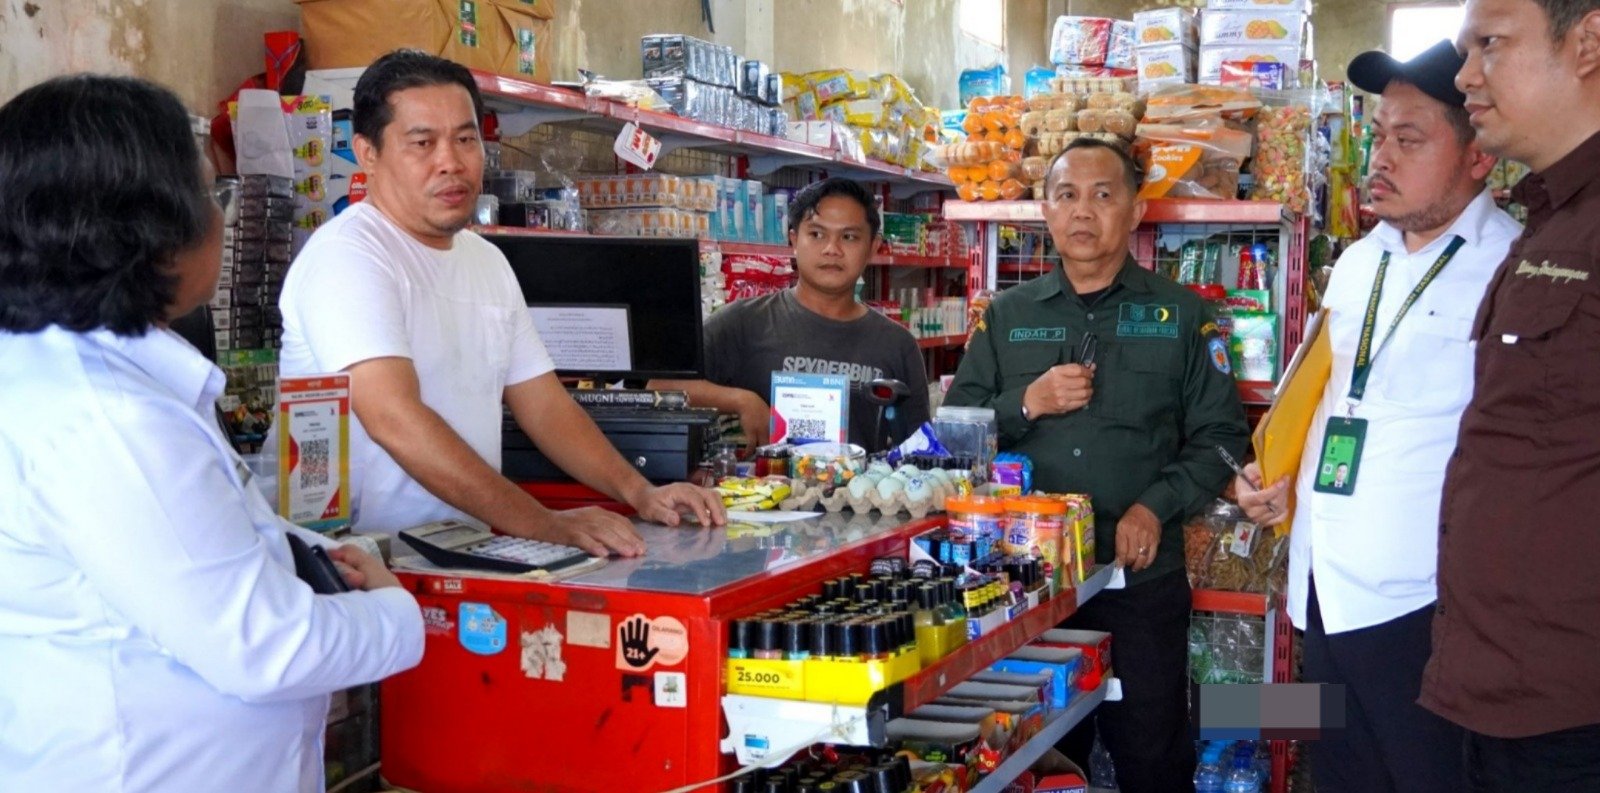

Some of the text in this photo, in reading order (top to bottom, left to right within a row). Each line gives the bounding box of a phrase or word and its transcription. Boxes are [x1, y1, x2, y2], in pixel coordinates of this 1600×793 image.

[1415, 253, 1449, 293] NASIONAL
[1356, 326, 1372, 368] NASIONAL
[626, 648, 646, 660] 21+
[737, 671, 780, 684] 25.000
